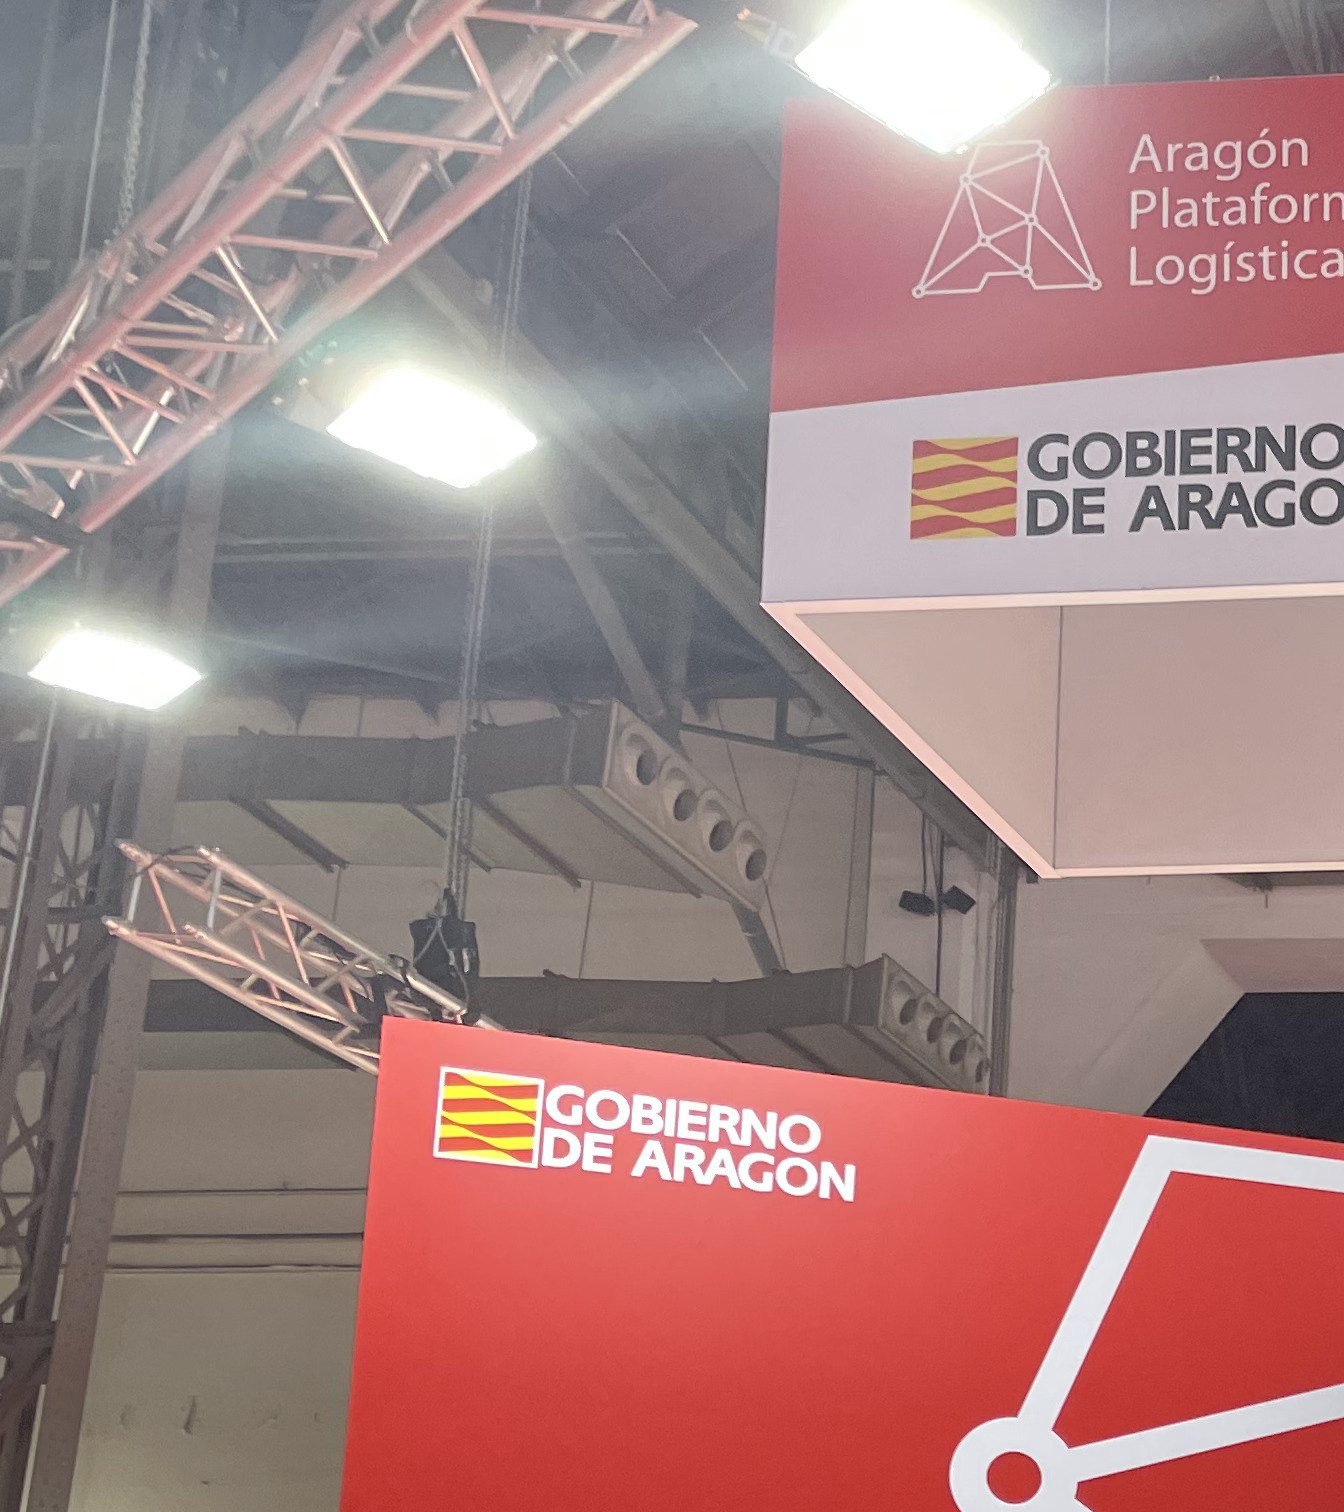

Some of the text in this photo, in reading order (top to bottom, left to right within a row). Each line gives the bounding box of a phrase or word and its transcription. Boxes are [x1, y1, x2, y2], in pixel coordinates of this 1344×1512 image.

[1129, 128, 1309, 181] Aragón
[1129, 240, 1344, 295] Logística
[1026, 487, 1105, 536] DE
[545, 1084, 822, 1154] GOBIERNO
[541, 1127, 856, 1202] DE ARAGON
